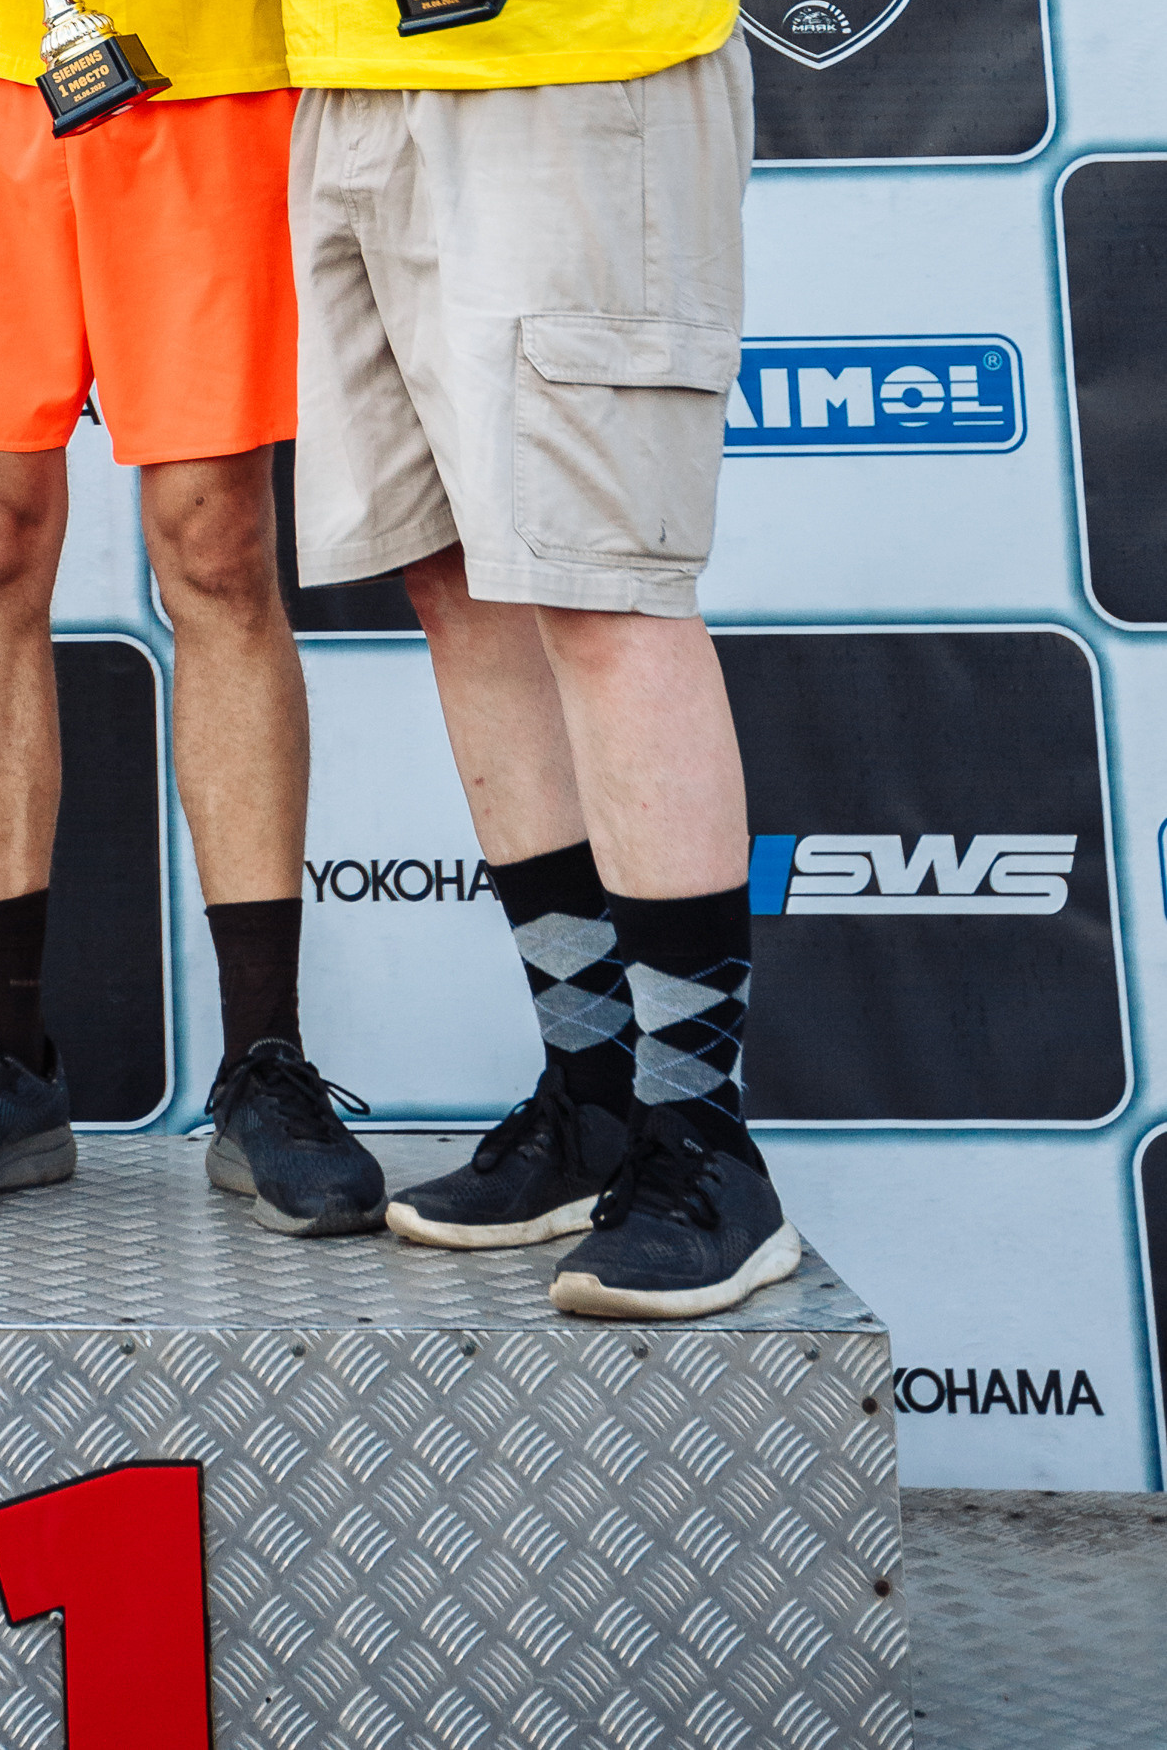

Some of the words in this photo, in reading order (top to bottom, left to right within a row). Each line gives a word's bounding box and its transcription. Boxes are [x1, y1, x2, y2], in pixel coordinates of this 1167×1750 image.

[52, 49, 103, 84] SIEMENS
[305, 859, 502, 902] YOKOHA
[785, 834, 1078, 915] SWS
[893, 1367, 1105, 1416] KOHAMA
